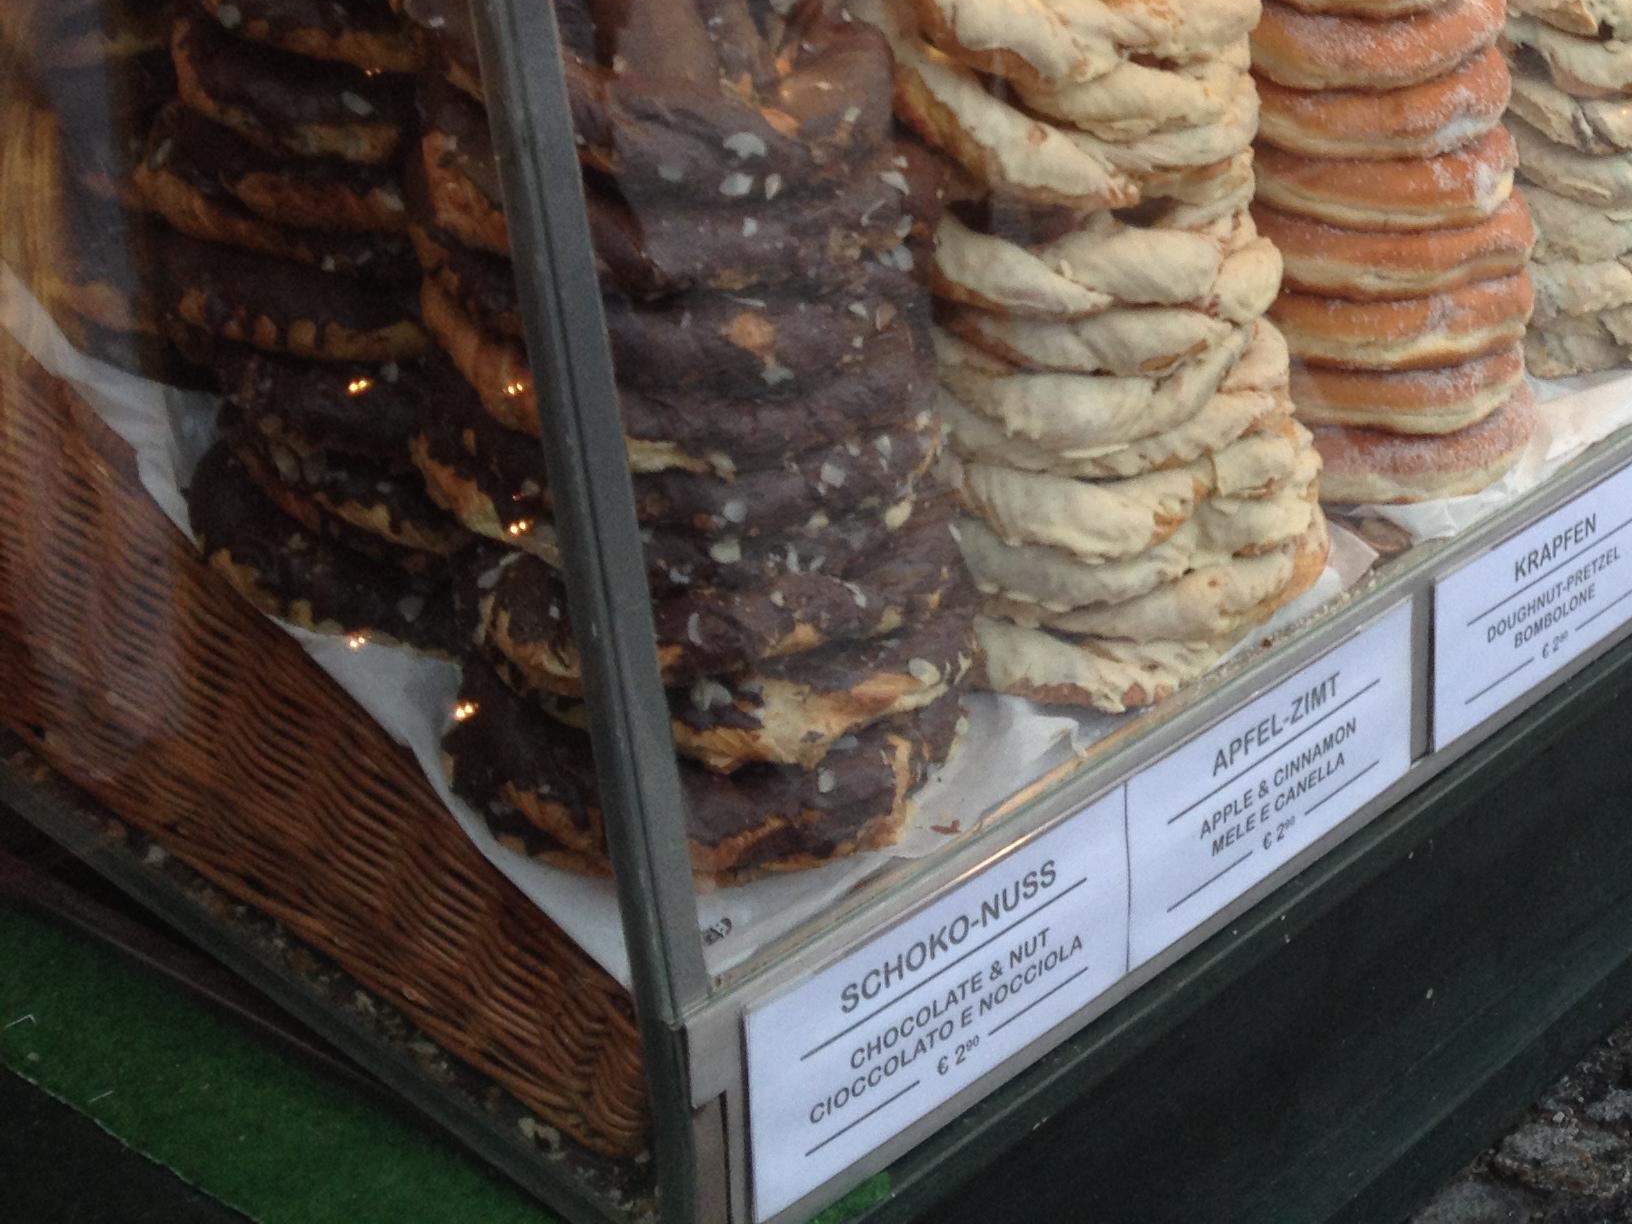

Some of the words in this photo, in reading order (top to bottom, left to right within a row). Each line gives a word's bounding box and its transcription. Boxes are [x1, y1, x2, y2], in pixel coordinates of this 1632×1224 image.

[1486, 546, 1621, 643] DOUGHNUT-PRETZEL
[1514, 513, 1597, 582] KRAPFEN
[1514, 583, 1597, 649] BOMBOLONE
[1213, 671, 1340, 777] APFEL-ZIMT
[1200, 789, 1253, 839] APPLE
[1258, 779, 1270, 799] &
[1273, 717, 1357, 787] CINNAMON
[1211, 815, 1255, 857] MELE
[1260, 803, 1271, 824] E
[1274, 752, 1345, 812] CANELLA
[1262, 831, 1273, 851] €
[840, 859, 1057, 1014] SCHOKO-NUSS
[809, 1020, 954, 1124] CIOCCOLATO
[960, 1005, 974, 1029] E
[979, 935, 1083, 1016] NOCCIOLA
[850, 971, 983, 1069] CHOCOLATE
[989, 959, 1003, 982] &
[1009, 927, 1051, 968] NUT
[936, 1054, 950, 1077] €
